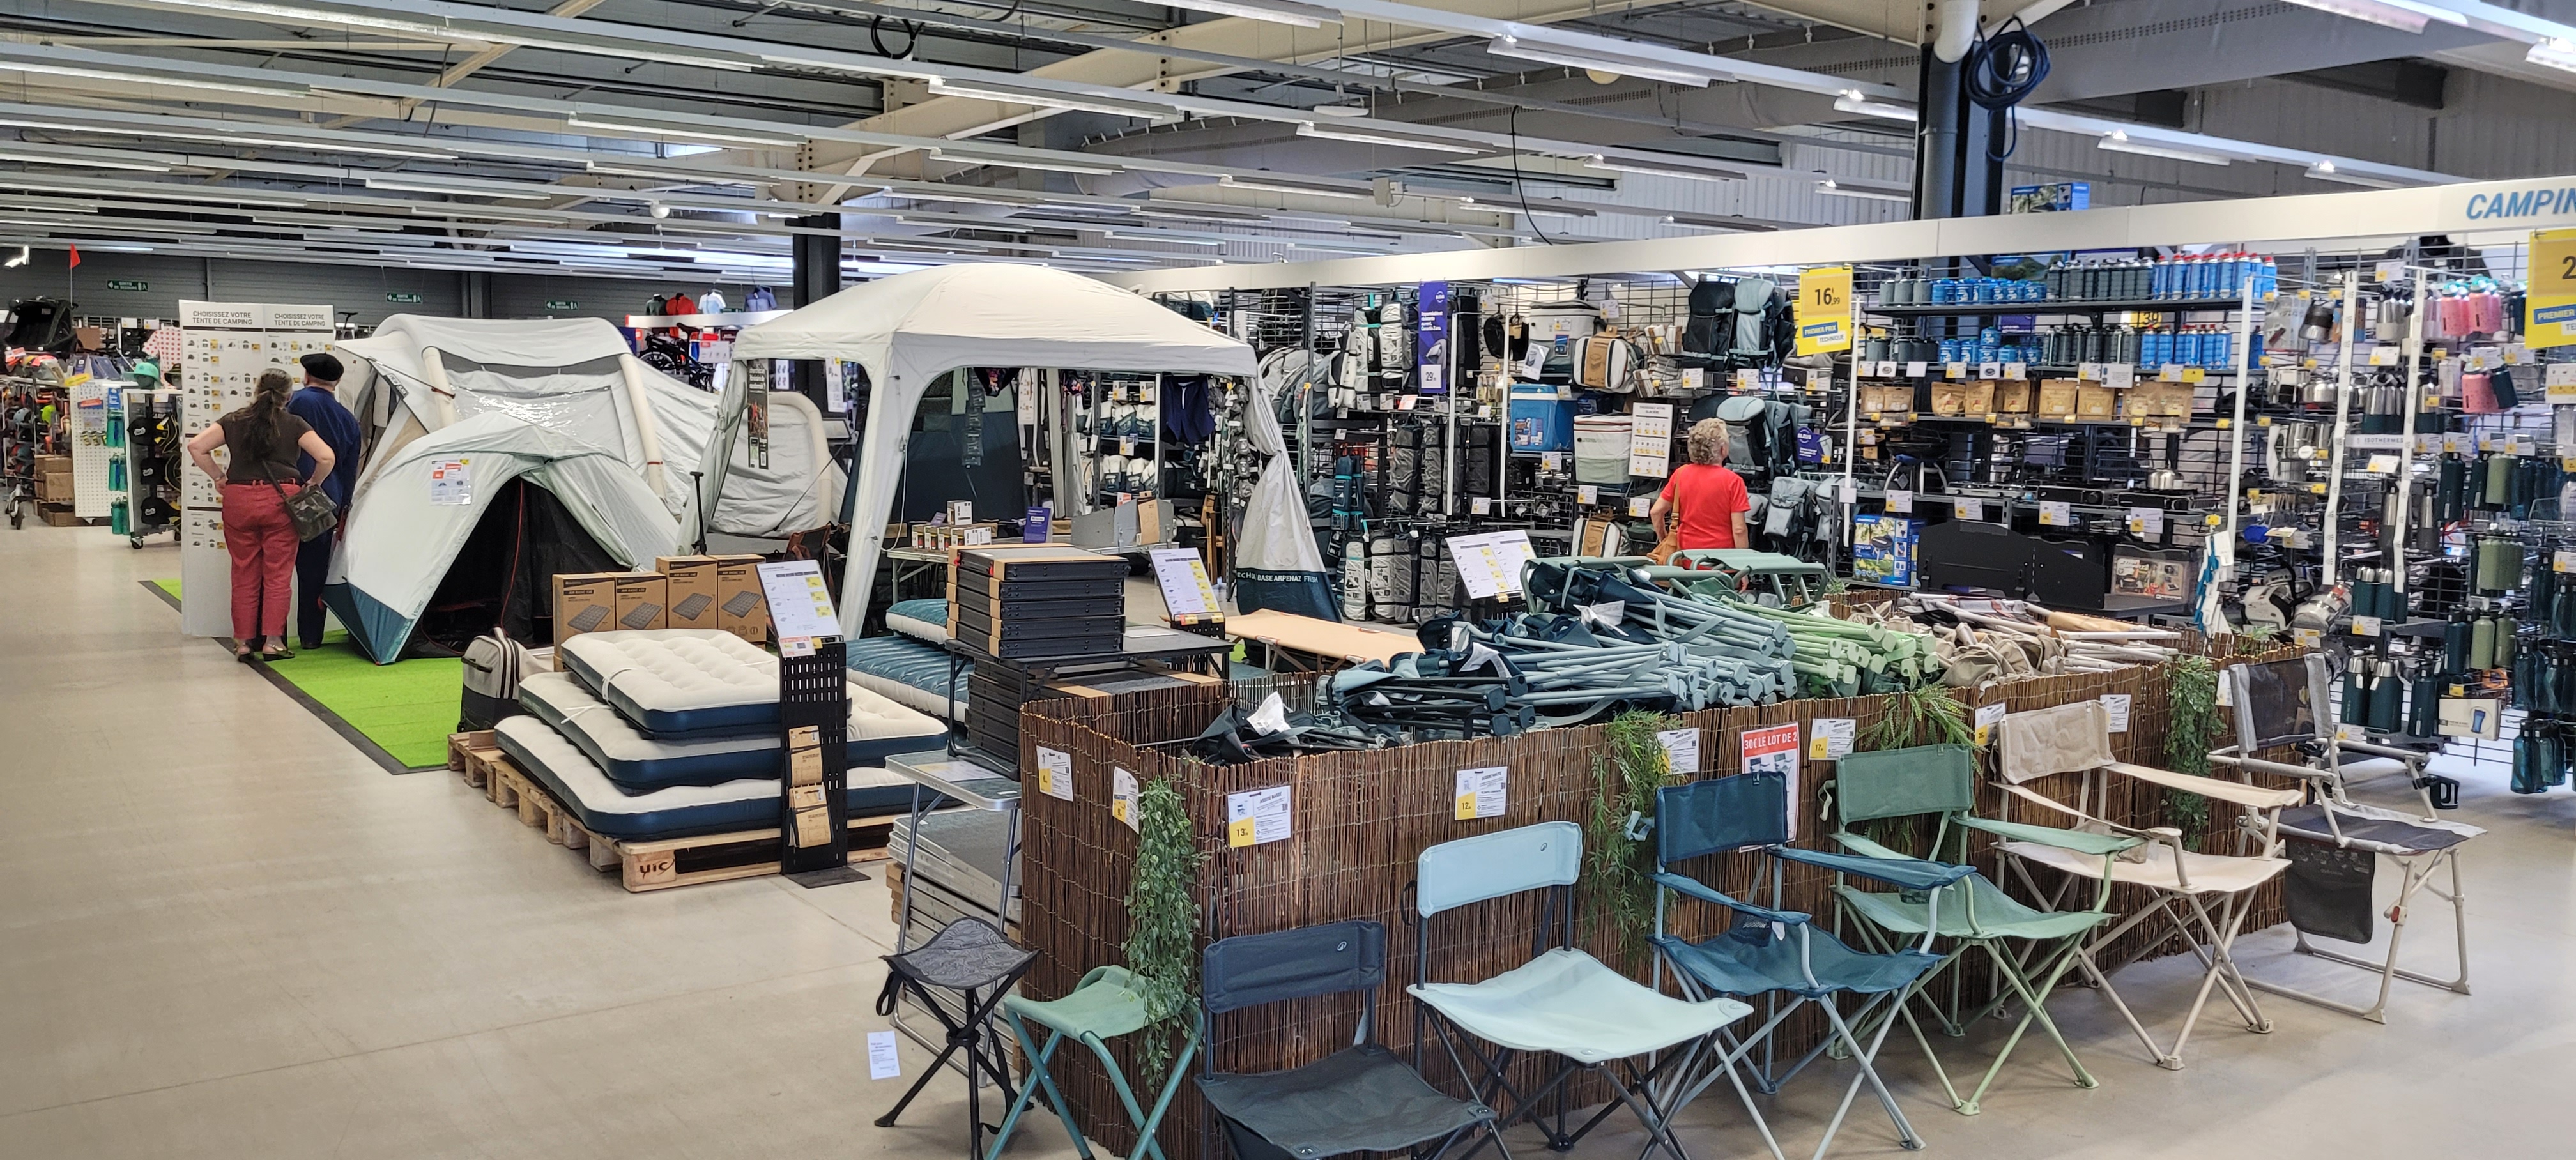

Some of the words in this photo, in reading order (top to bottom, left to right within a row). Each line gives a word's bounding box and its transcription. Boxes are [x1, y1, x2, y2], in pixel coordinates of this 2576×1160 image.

[2537, 309, 2575, 320] PREMIER
[1819, 334, 1844, 343] TECHNIQUE
[1744, 738, 1758, 750] 30€
[1758, 736, 1767, 747] LE
[1767, 734, 1781, 746] LOT
[1782, 732, 1791, 744] DE
[1793, 731, 1798, 742] 2
